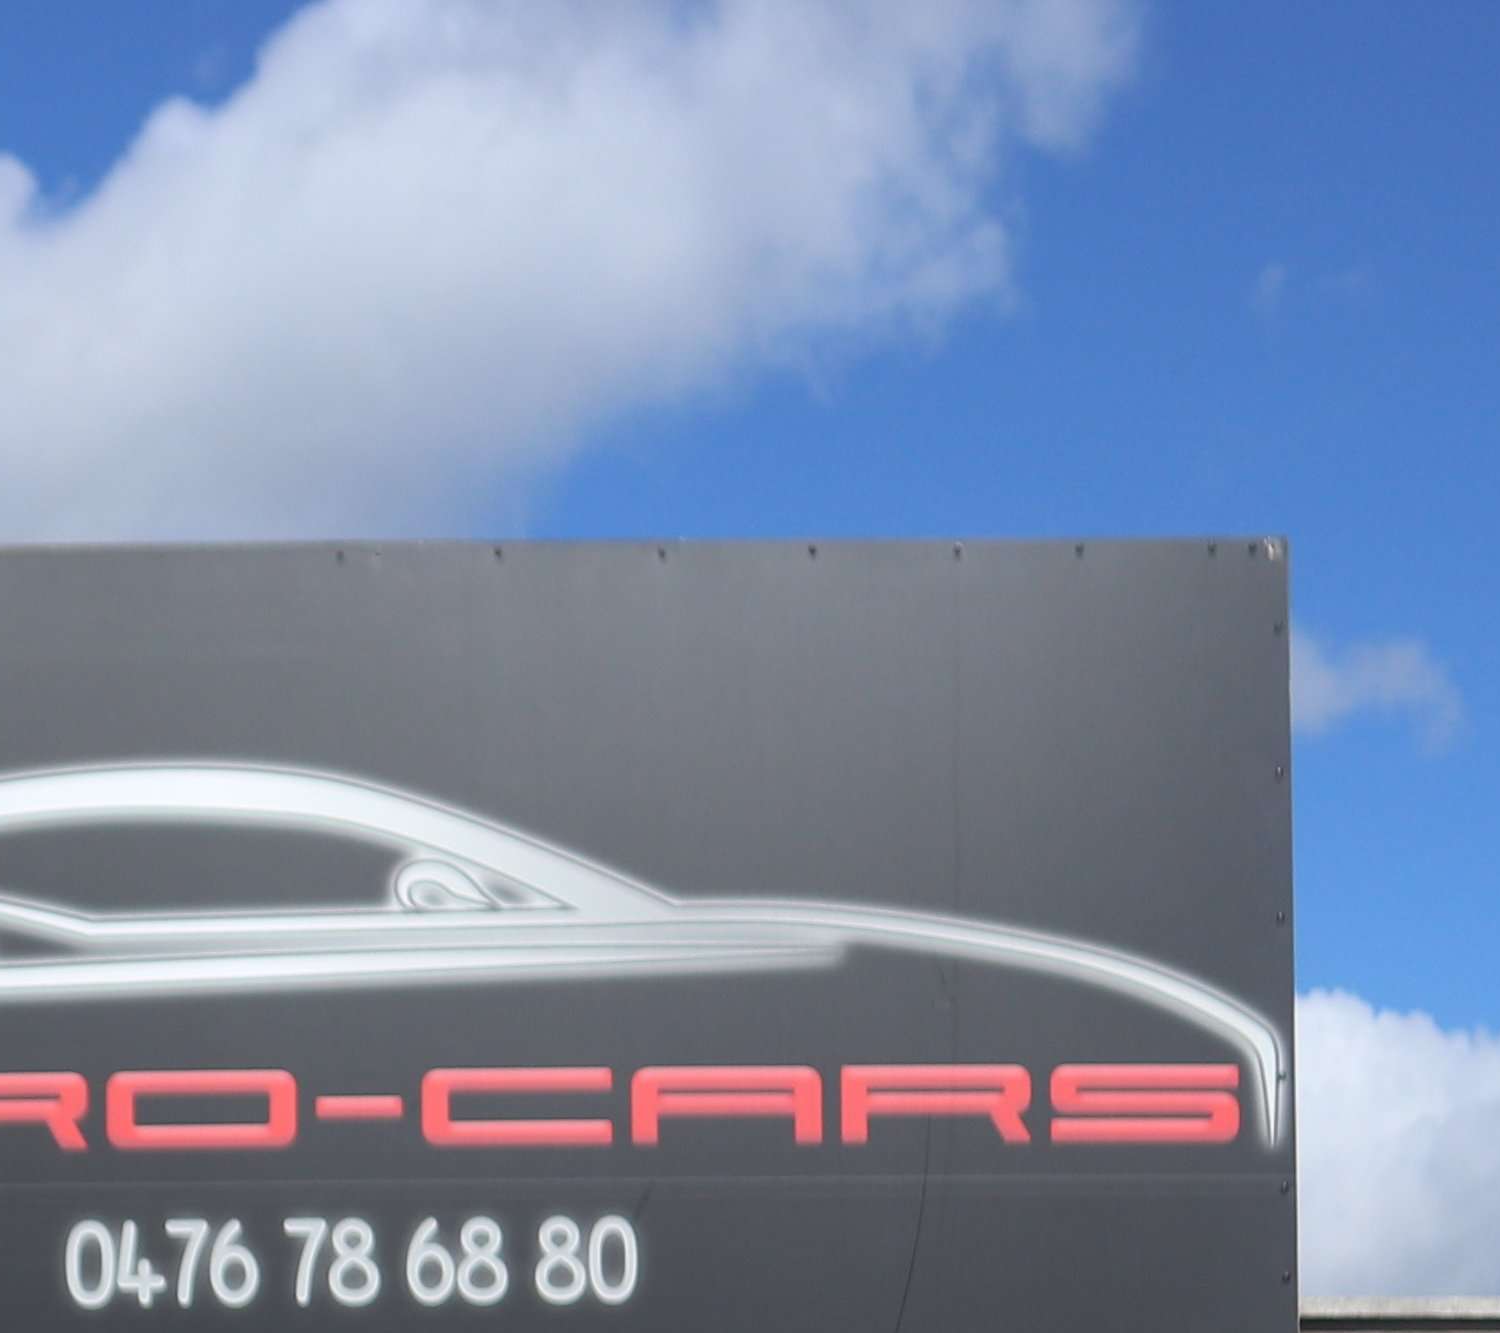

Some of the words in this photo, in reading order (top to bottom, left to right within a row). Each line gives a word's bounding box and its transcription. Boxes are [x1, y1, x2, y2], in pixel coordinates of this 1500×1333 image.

[64, 1217, 261, 1310] 0476
[282, 1216, 382, 1307] 78
[405, 1215, 510, 1307] 68
[533, 1214, 639, 1306] 80
